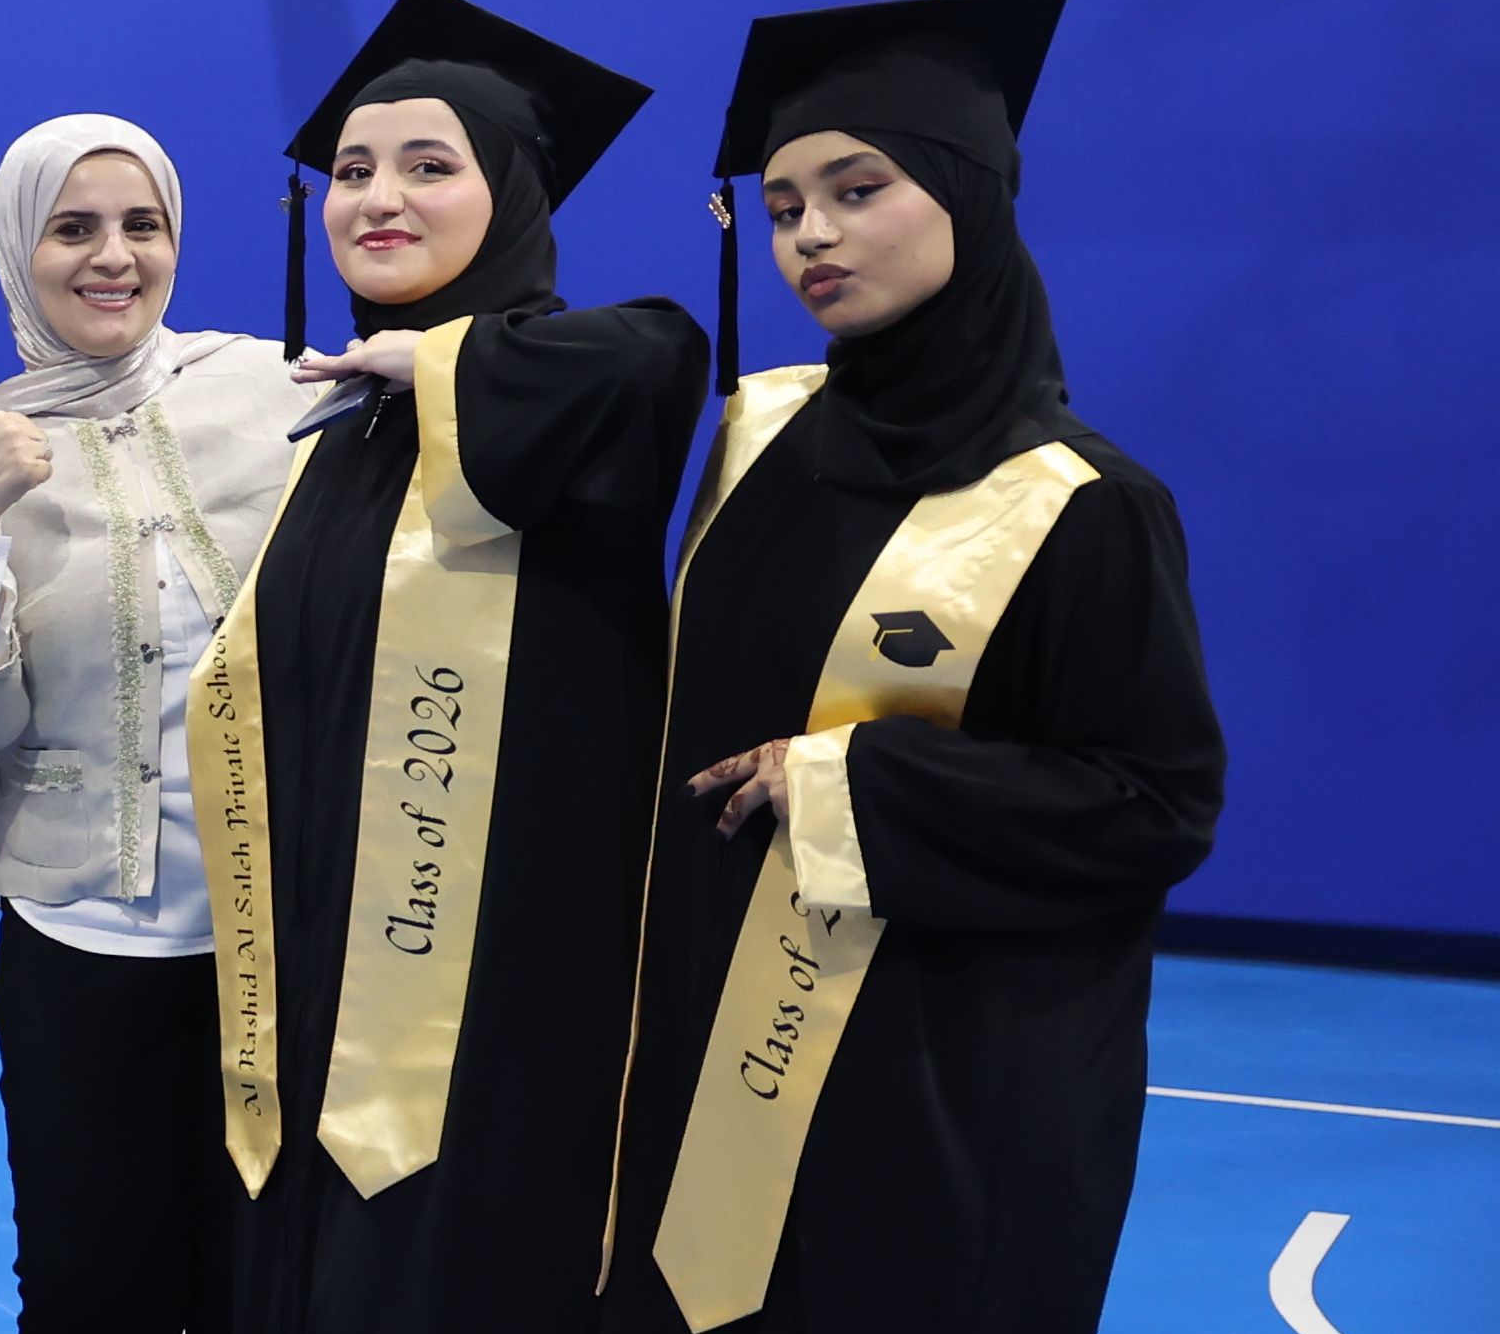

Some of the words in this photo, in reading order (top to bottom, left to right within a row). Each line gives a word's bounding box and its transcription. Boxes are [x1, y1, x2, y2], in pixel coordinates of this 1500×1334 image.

[403, 665, 465, 794] 2026
[224, 732, 249, 832] Private
[400, 801, 448, 849] of
[231, 841, 253, 918] Saleh
[385, 860, 443, 957] Class
[236, 928, 256, 962] Al
[238, 973, 259, 1072] Rashid
[740, 999, 805, 1101] Class
[778, 934, 821, 992] of
[240, 1082, 262, 1117] Al
